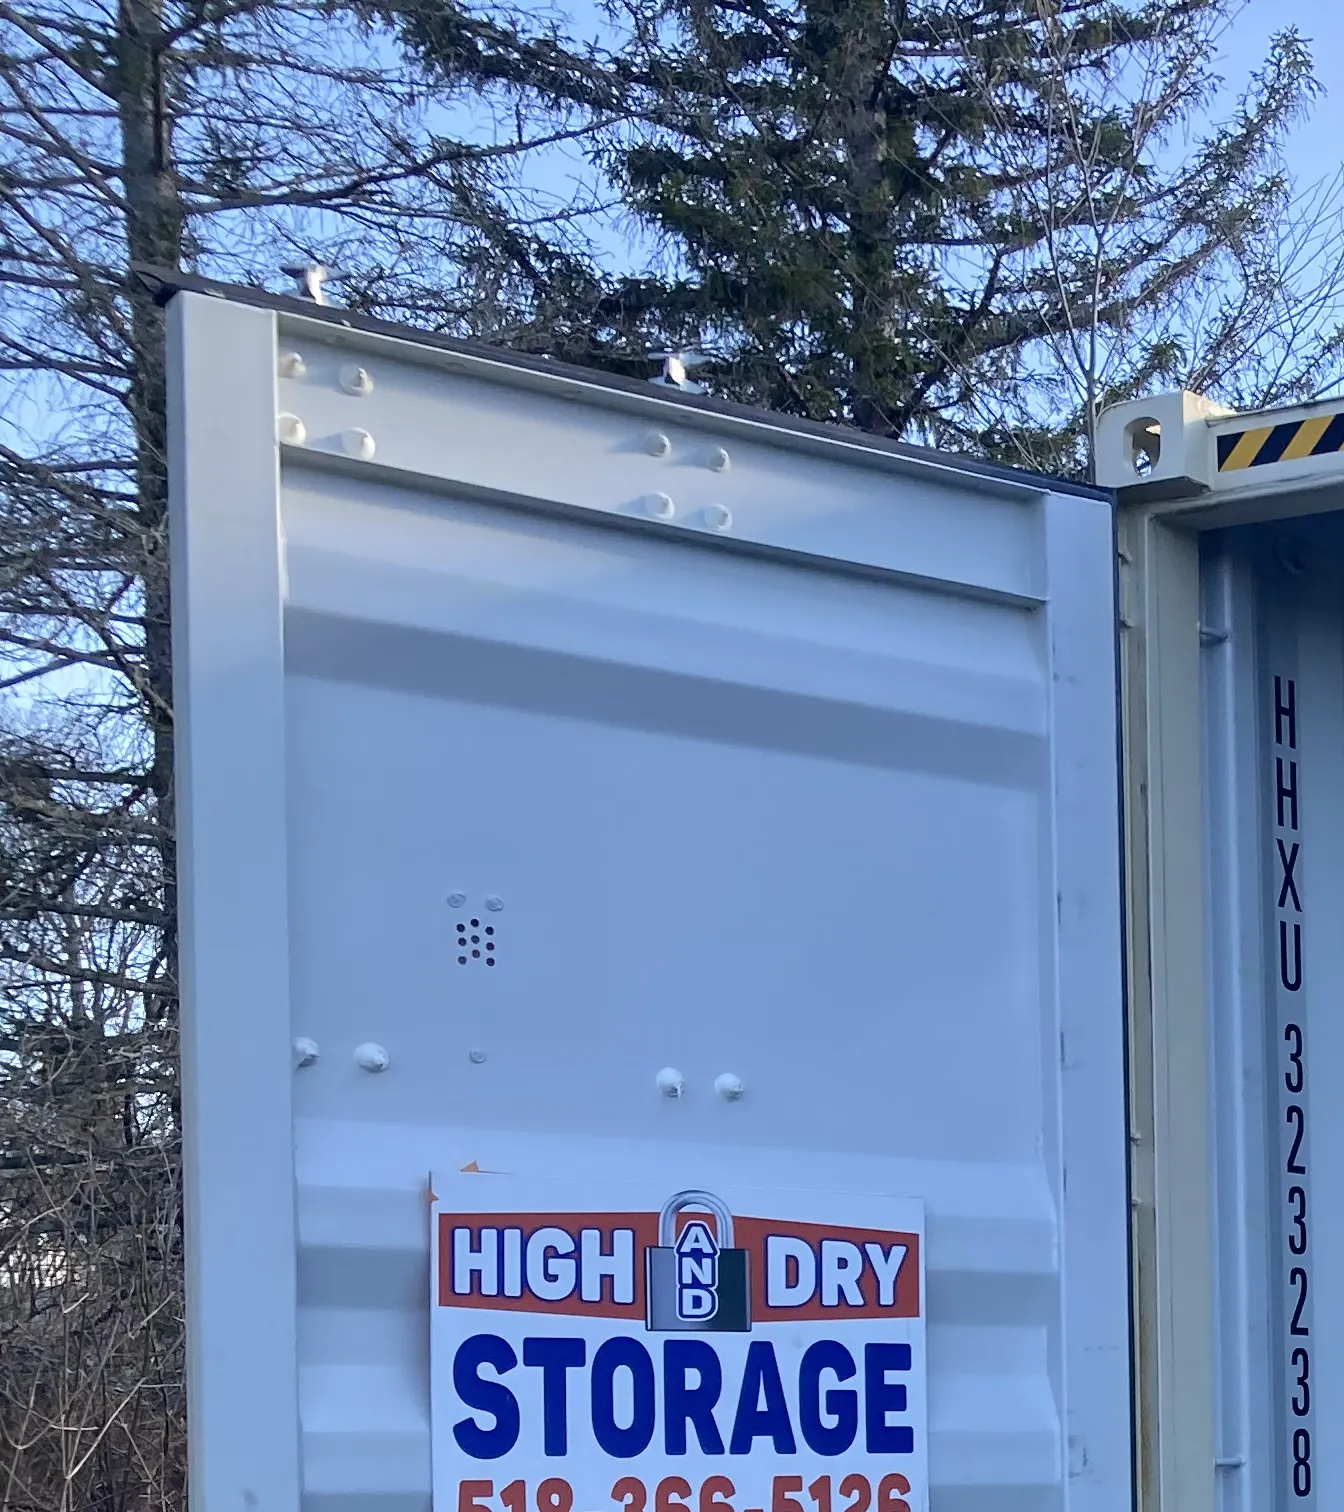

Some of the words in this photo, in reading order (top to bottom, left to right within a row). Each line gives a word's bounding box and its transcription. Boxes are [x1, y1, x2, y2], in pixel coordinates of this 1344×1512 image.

[1274, 675, 1302, 991] HHXU
[452, 1226, 635, 1304] HIGH
[676, 1221, 719, 1320] AND
[765, 1234, 907, 1308] DRY
[1284, 1023, 1311, 1498] 323238
[452, 1333, 914, 1459] STORAGE
